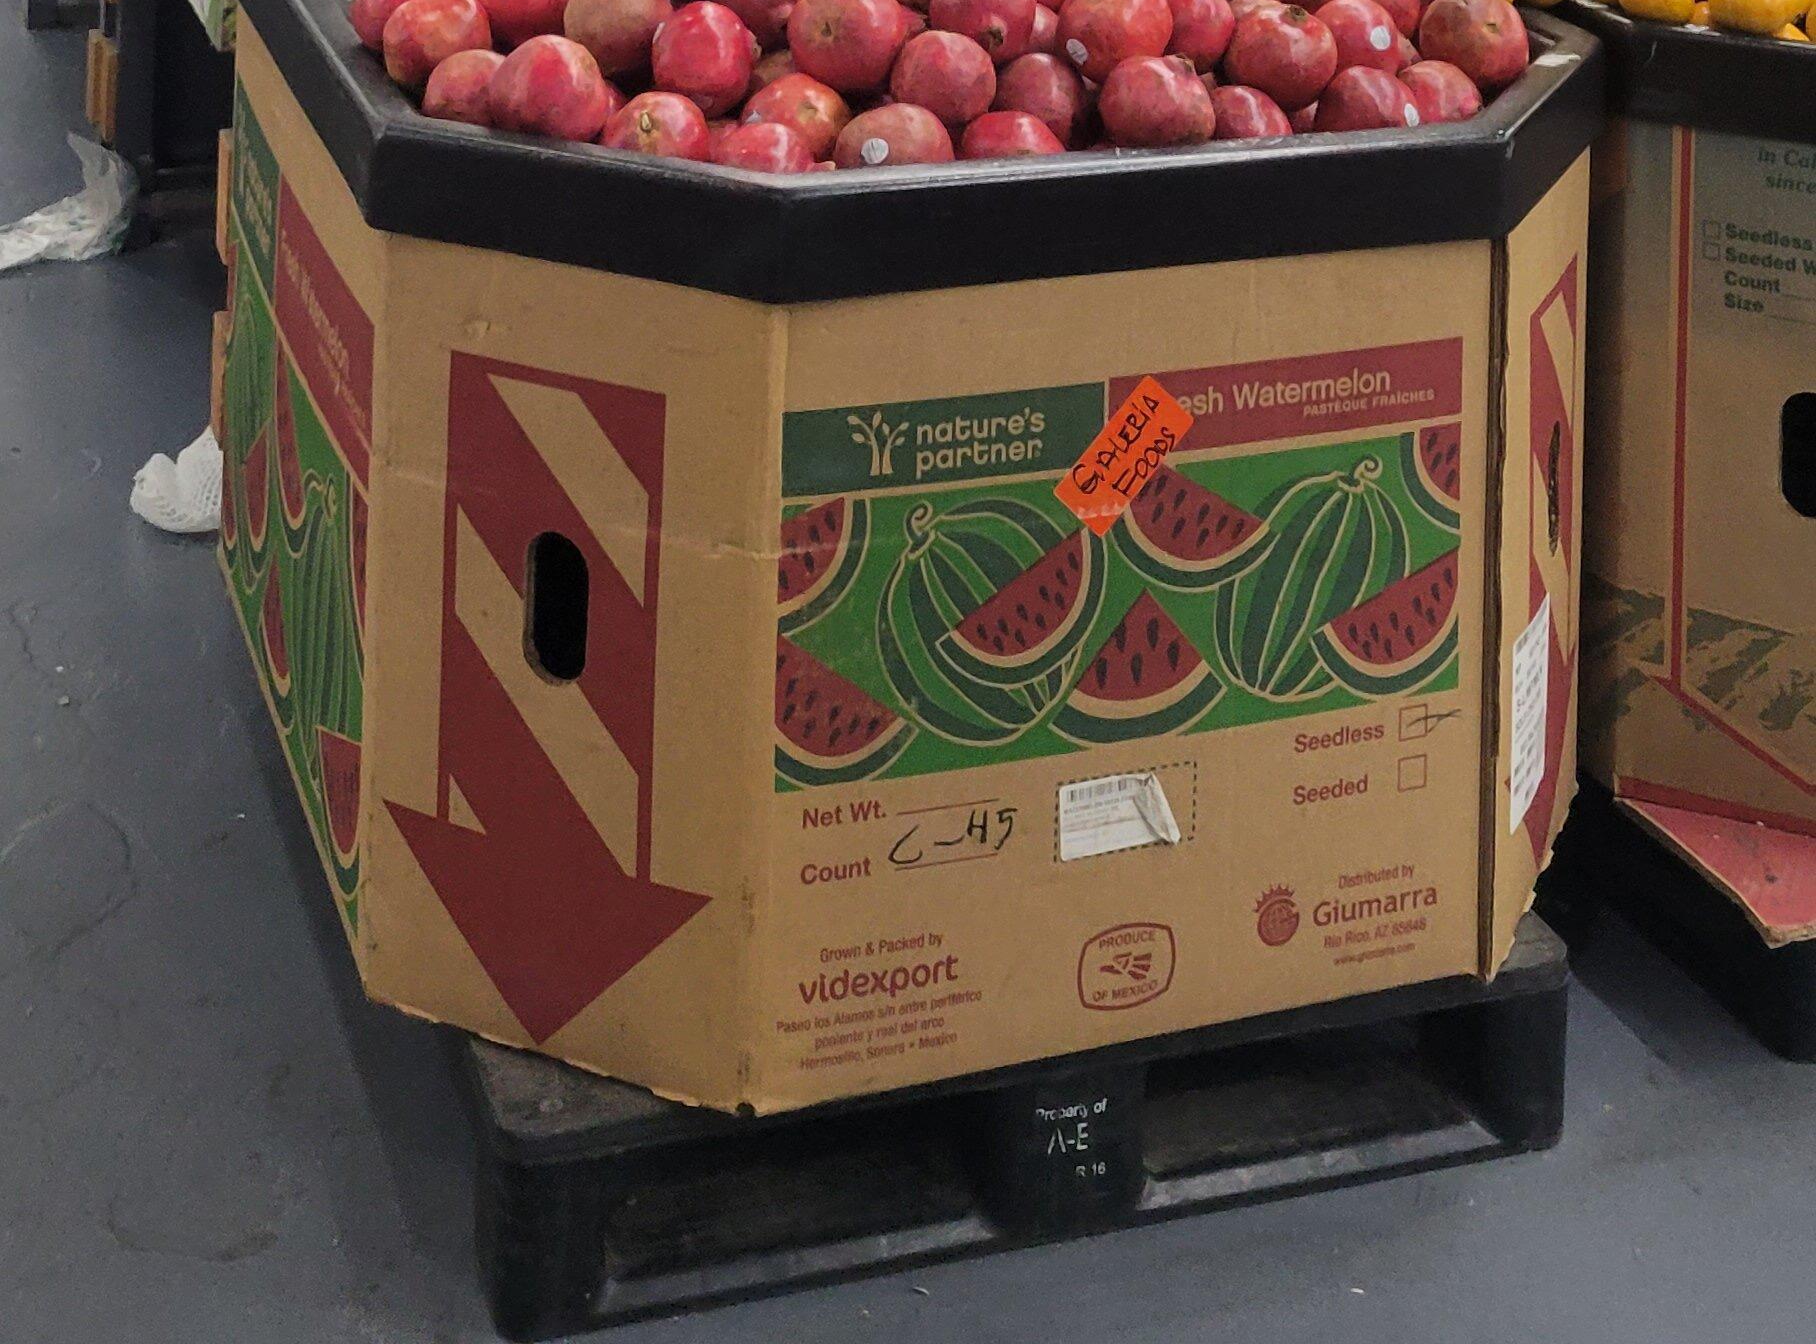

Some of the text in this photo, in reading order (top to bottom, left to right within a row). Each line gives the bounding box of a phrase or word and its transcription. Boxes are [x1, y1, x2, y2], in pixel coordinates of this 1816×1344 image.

[1724, 222, 1814, 251] Seedless
[1724, 247, 1797, 272] Seeded
[1724, 269, 1781, 294] Count
[1723, 292, 1765, 312] Size
[1177, 368, 1391, 416] esh Watermelon
[916, 406, 1045, 446] nature's
[916, 436, 1044, 479] partner
[1112, 426, 1175, 496] FOODS
[1294, 723, 1385, 753] Seedless
[1292, 775, 1369, 805] Seeded
[802, 800, 887, 830] Net Wt.
[800, 857, 872, 886] Count
[1338, 864, 1415, 889] Distributed by
[1313, 886, 1438, 927] Giumarra
[820, 932, 944, 963] Grown & Packed by
[1100, 929, 1157, 950] PRODUCE
[799, 954, 960, 1005] videxport
[1092, 979, 1158, 1003] OF MEXICO
